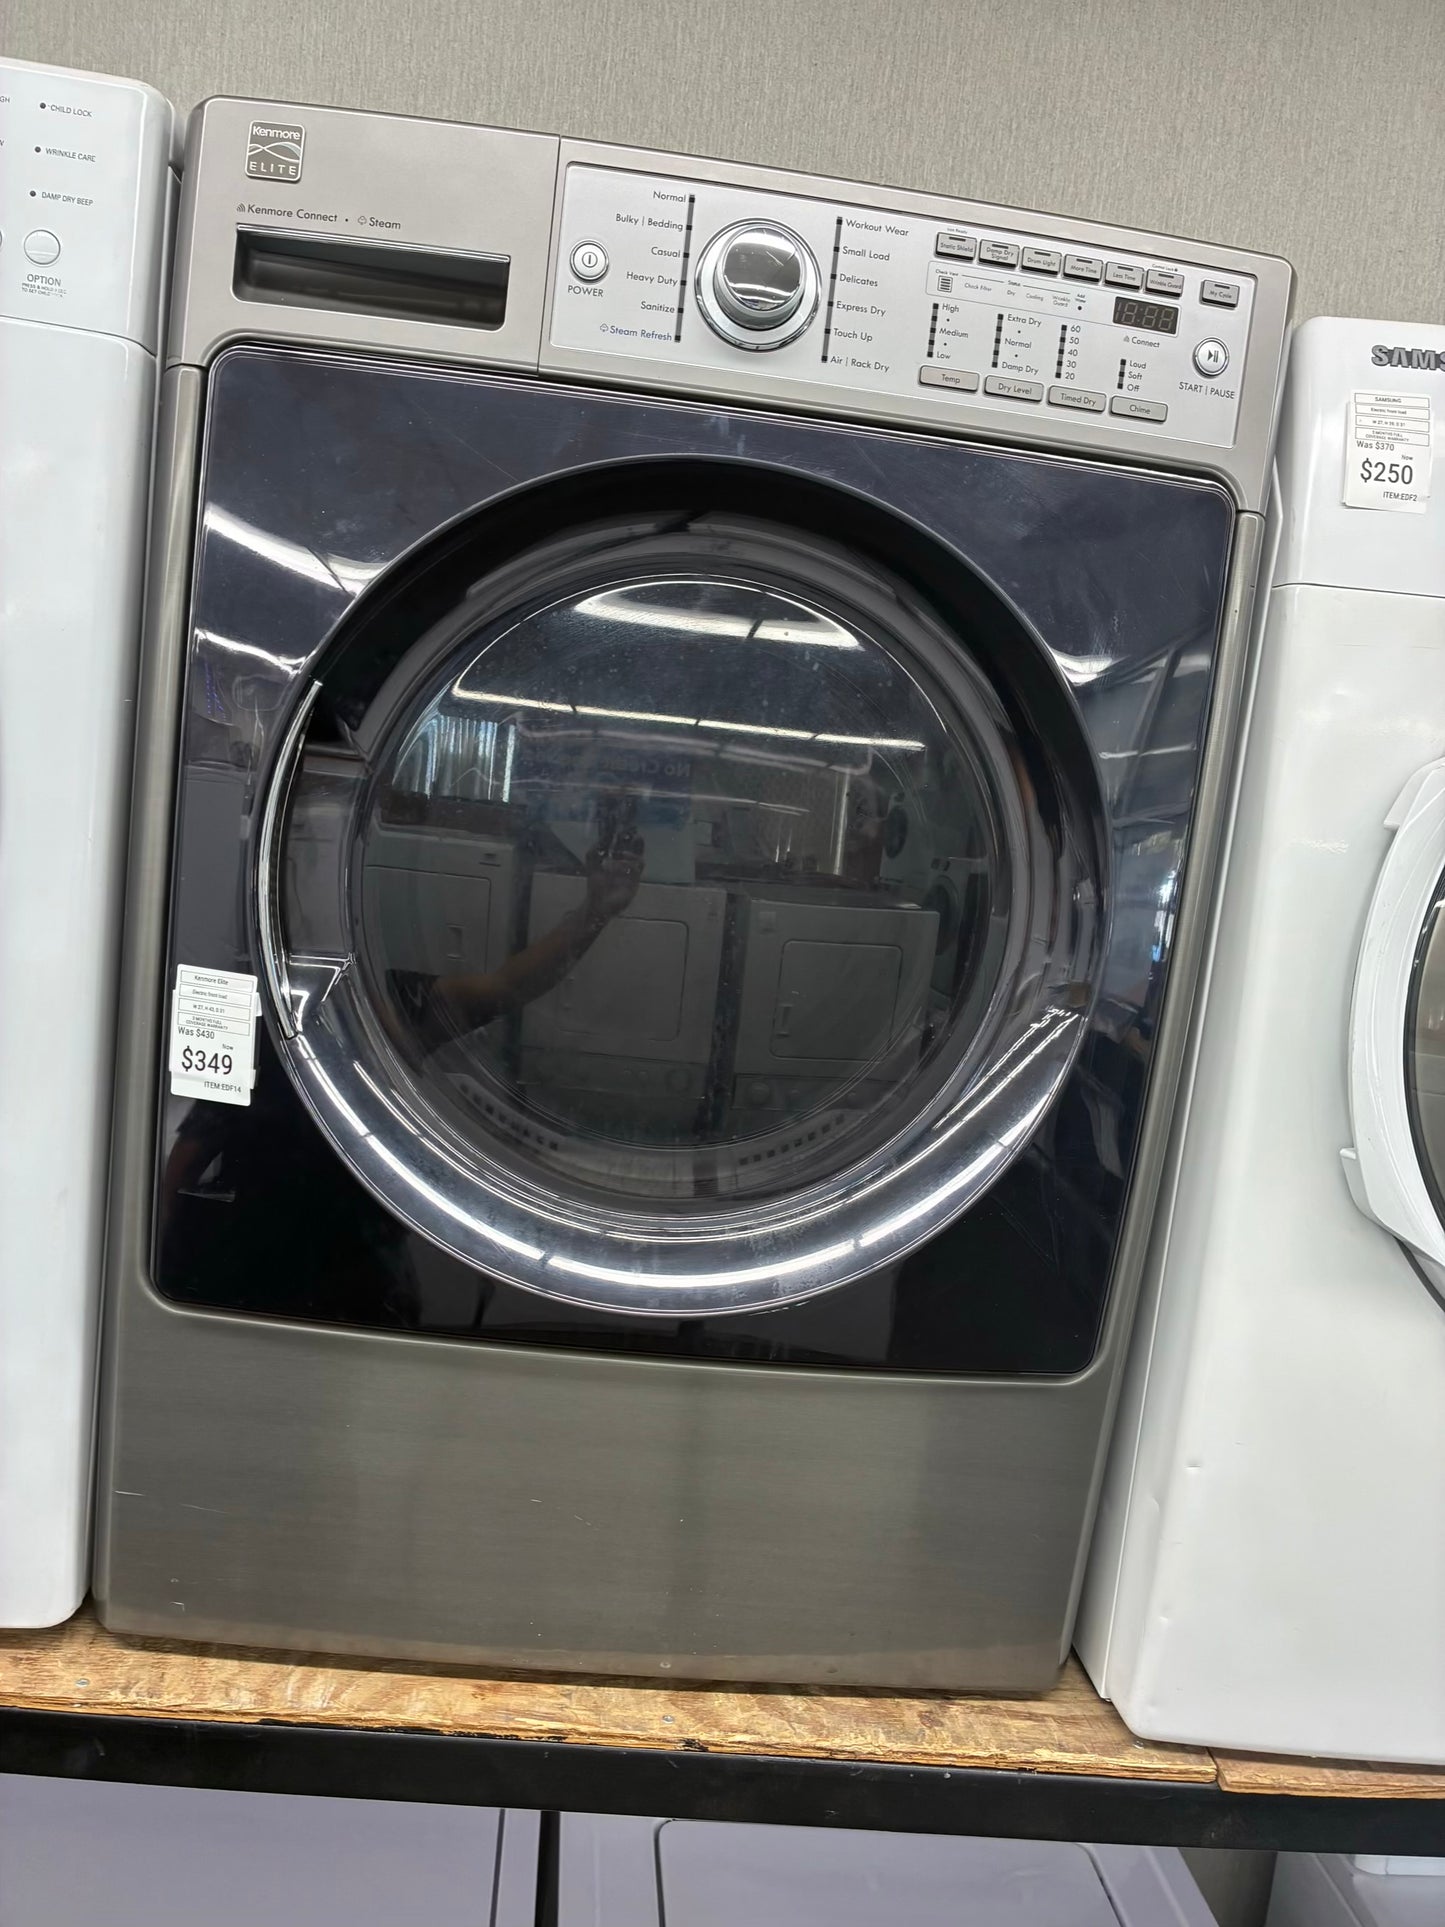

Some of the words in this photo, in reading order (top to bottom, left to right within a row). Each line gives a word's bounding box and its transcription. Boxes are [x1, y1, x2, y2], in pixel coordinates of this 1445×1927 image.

[50, 104, 72, 114] CHILD
[73, 107, 92, 118] LOCK
[252, 125, 301, 140] Kenmore
[46, 147, 77, 160] WRINKLE
[78, 153, 96, 162] CARE
[249, 161, 297, 176] ELITE
[41, 192, 62, 202] DAMP
[62, 195, 76, 205] DRY
[77, 197, 94, 207] BEEP
[653, 191, 686, 203] Normal
[247, 204, 294, 218] Kenmore
[296, 209, 338, 223] Connect
[369, 217, 402, 230] Steam
[616, 213, 639, 226] Bulky
[648, 217, 684, 232] Bedding
[846, 219, 882, 232] Workout
[885, 225, 910, 236] Wear
[651, 246, 681, 258] Casual
[842, 246, 866, 258] Small
[869, 250, 890, 262] Load
[1027, 257, 1042, 265] Drum
[1043, 259, 1056, 268] Light
[27, 273, 62, 287] OPTION
[626, 271, 655, 284] Heavy
[657, 275, 678, 287] Duty
[840, 274, 878, 287] Delicates
[1125, 274, 1136, 282] Time
[567, 285, 604, 298] POWER
[1167, 282, 1182, 290] Guard
[1007, 289, 1016, 297] Dry
[1218, 291, 1232, 300] Cycle
[640, 301, 676, 314] Sanitize
[836, 301, 868, 314] Express
[871, 306, 886, 317] Dry
[942, 303, 960, 313] High
[1007, 314, 1027, 324] Extra
[1028, 317, 1042, 328] Dry
[610, 325, 638, 337] Steam
[640, 329, 672, 342] Refresh
[834, 328, 858, 340] Touch
[860, 332, 873, 342] Up
[939, 328, 969, 338] Medium
[1070, 325, 1082, 334] 60
[1004, 338, 1032, 350] Normal
[1069, 337, 1080, 346] 50
[1131, 336, 1160, 348] Connect
[936, 352, 951, 360] Low
[1067, 349, 1078, 357] 40
[830, 356, 843, 364] Air
[851, 359, 872, 369] Rack
[874, 362, 890, 373] Dry
[1001, 361, 1024, 373] Damp
[1025, 365, 1040, 376] Dry
[1066, 360, 1077, 369] 30
[1130, 361, 1147, 370] Loud
[941, 373, 961, 384] Temp
[1065, 372, 1076, 381] 20
[1128, 372, 1143, 381] Soft
[999, 383, 1012, 393] Dry
[1013, 385, 1032, 395] Level
[1126, 383, 1140, 392] Off
[1178, 381, 1203, 394] START
[1209, 387, 1236, 400] PAUSE
[1061, 392, 1082, 404] Timed
[1083, 397, 1096, 407] Dry
[1129, 404, 1151, 415] Chime
[1357, 440, 1374, 450] Was
[1375, 442, 1395, 452] $370
[1360, 458, 1414, 485] $250
[194, 975, 216, 984] Kenmore
[217, 978, 229, 986] Elite
[178, 1026, 194, 1036] Was
[196, 1029, 215, 1040] $430
[181, 1045, 233, 1075] $349
